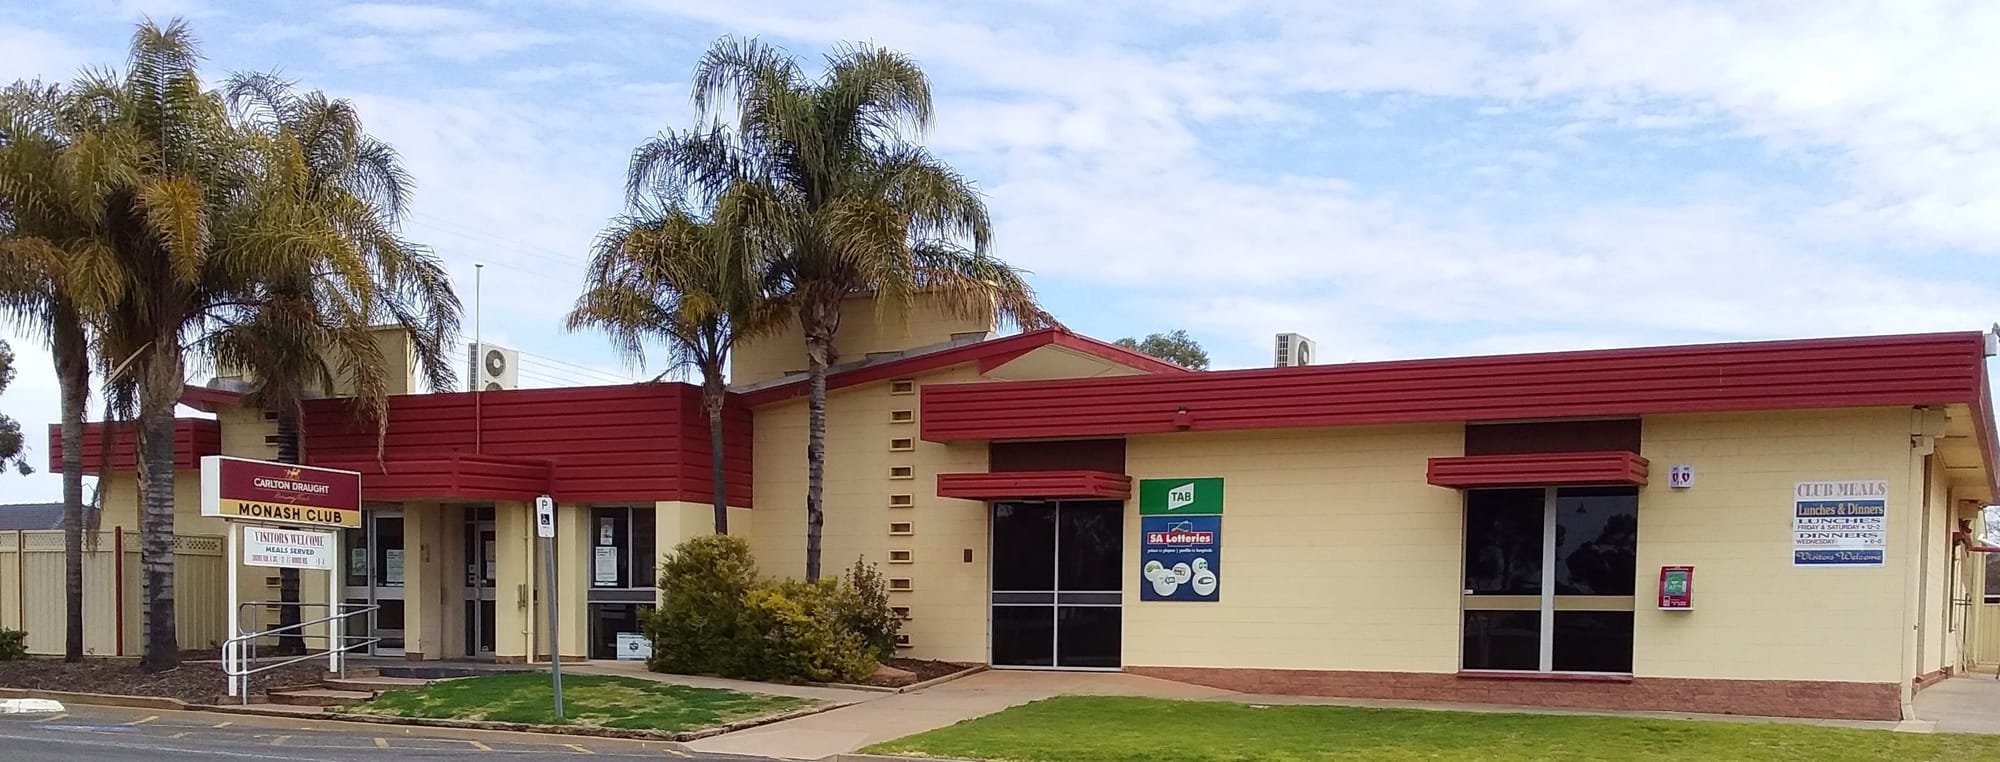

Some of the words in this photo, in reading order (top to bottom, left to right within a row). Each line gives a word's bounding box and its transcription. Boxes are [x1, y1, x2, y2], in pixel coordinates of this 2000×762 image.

[253, 478, 290, 490] CARLTON
[292, 482, 330, 494] DRAUGHT
[1797, 483, 1833, 497] CLUB
[1837, 482, 1886, 496] MEALS
[1171, 491, 1192, 502] TAB
[541, 499, 548, 510] P
[1798, 503, 1835, 515] Lunches
[1837, 503, 1846, 515] &
[1848, 502, 1883, 515] Dinners
[239, 503, 300, 519] MONASH
[306, 509, 342, 523] CLUB
[255, 531, 289, 543] VISITORS
[291, 534, 325, 546] WELCOME
[1150, 534, 1163, 543] SA
[1166, 533, 1211, 543] Lotteries
[265, 546, 289, 554] MEALS
[290, 547, 315, 555] SERVED
